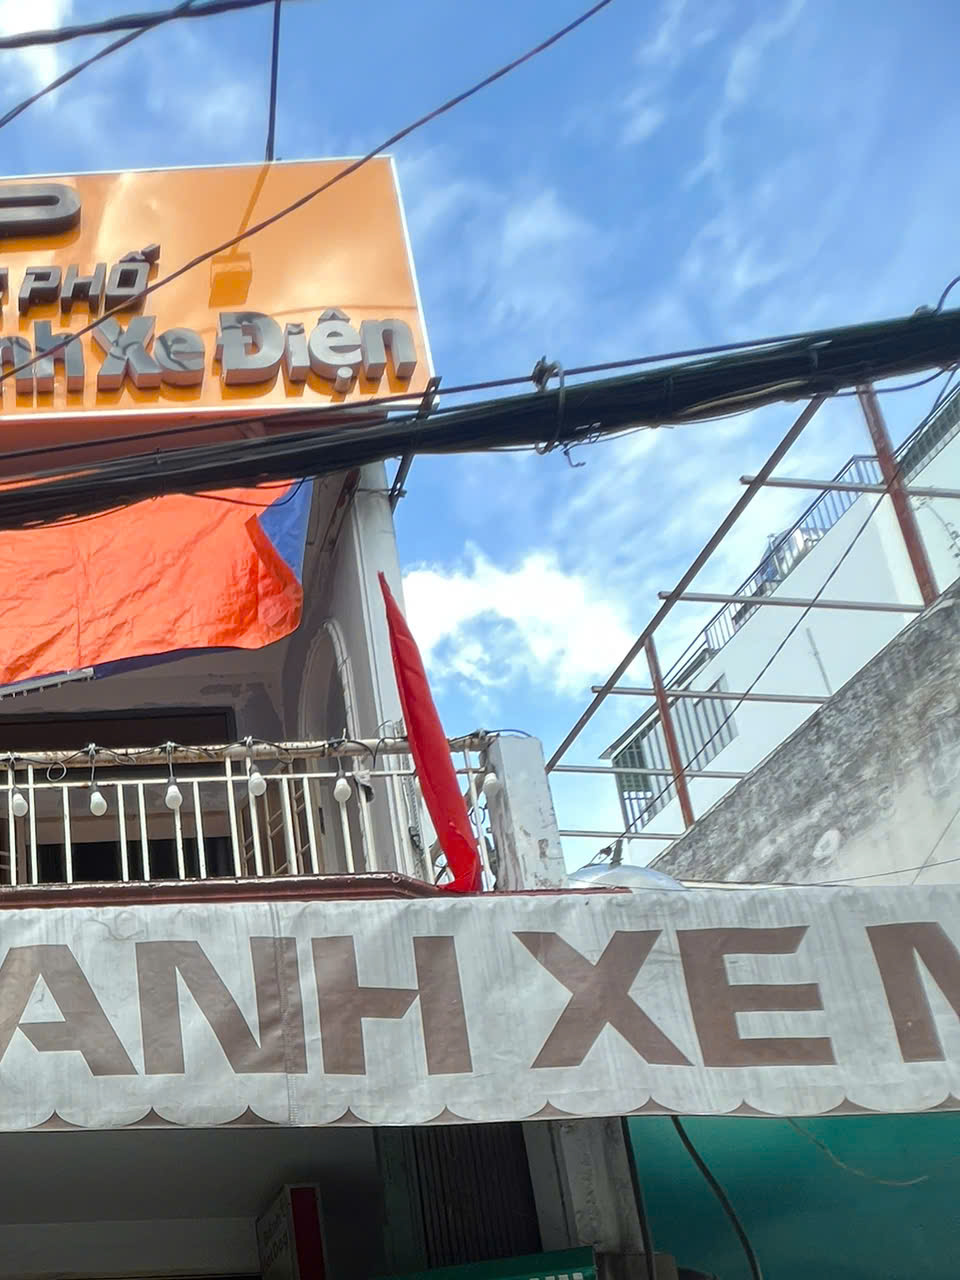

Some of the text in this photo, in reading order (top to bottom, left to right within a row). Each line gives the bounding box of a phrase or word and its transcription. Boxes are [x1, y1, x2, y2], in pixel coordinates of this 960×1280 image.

[17, 242, 161, 315] PHỐ
[91, 314, 206, 390] Xe
[214, 306, 418, 393] Điện
[514, 925, 837, 1069] XE
